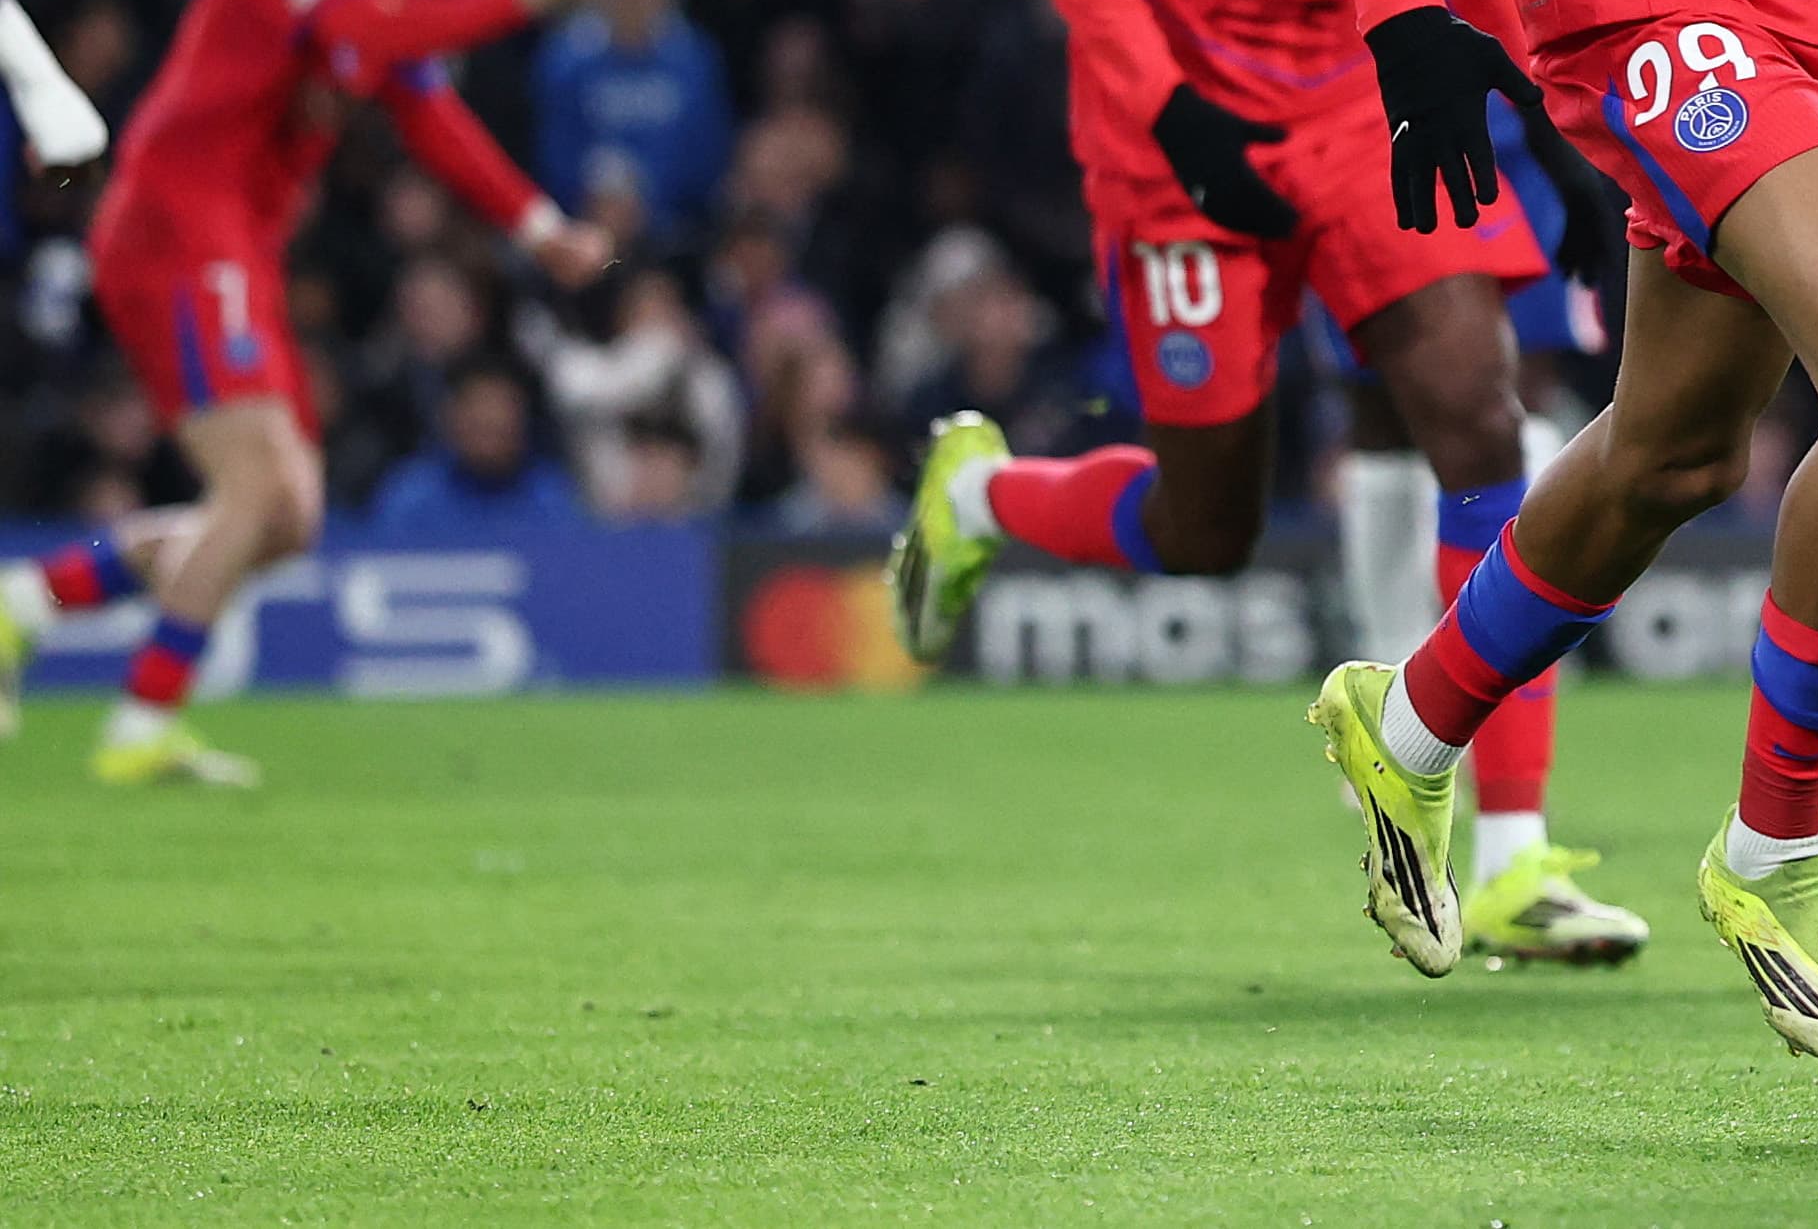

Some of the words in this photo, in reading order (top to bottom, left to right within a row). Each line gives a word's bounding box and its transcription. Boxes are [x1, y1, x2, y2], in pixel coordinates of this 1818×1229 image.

[1627, 21, 1757, 127] 99
[1680, 92, 1723, 122] PARIS
[1132, 239, 1225, 328] 10
